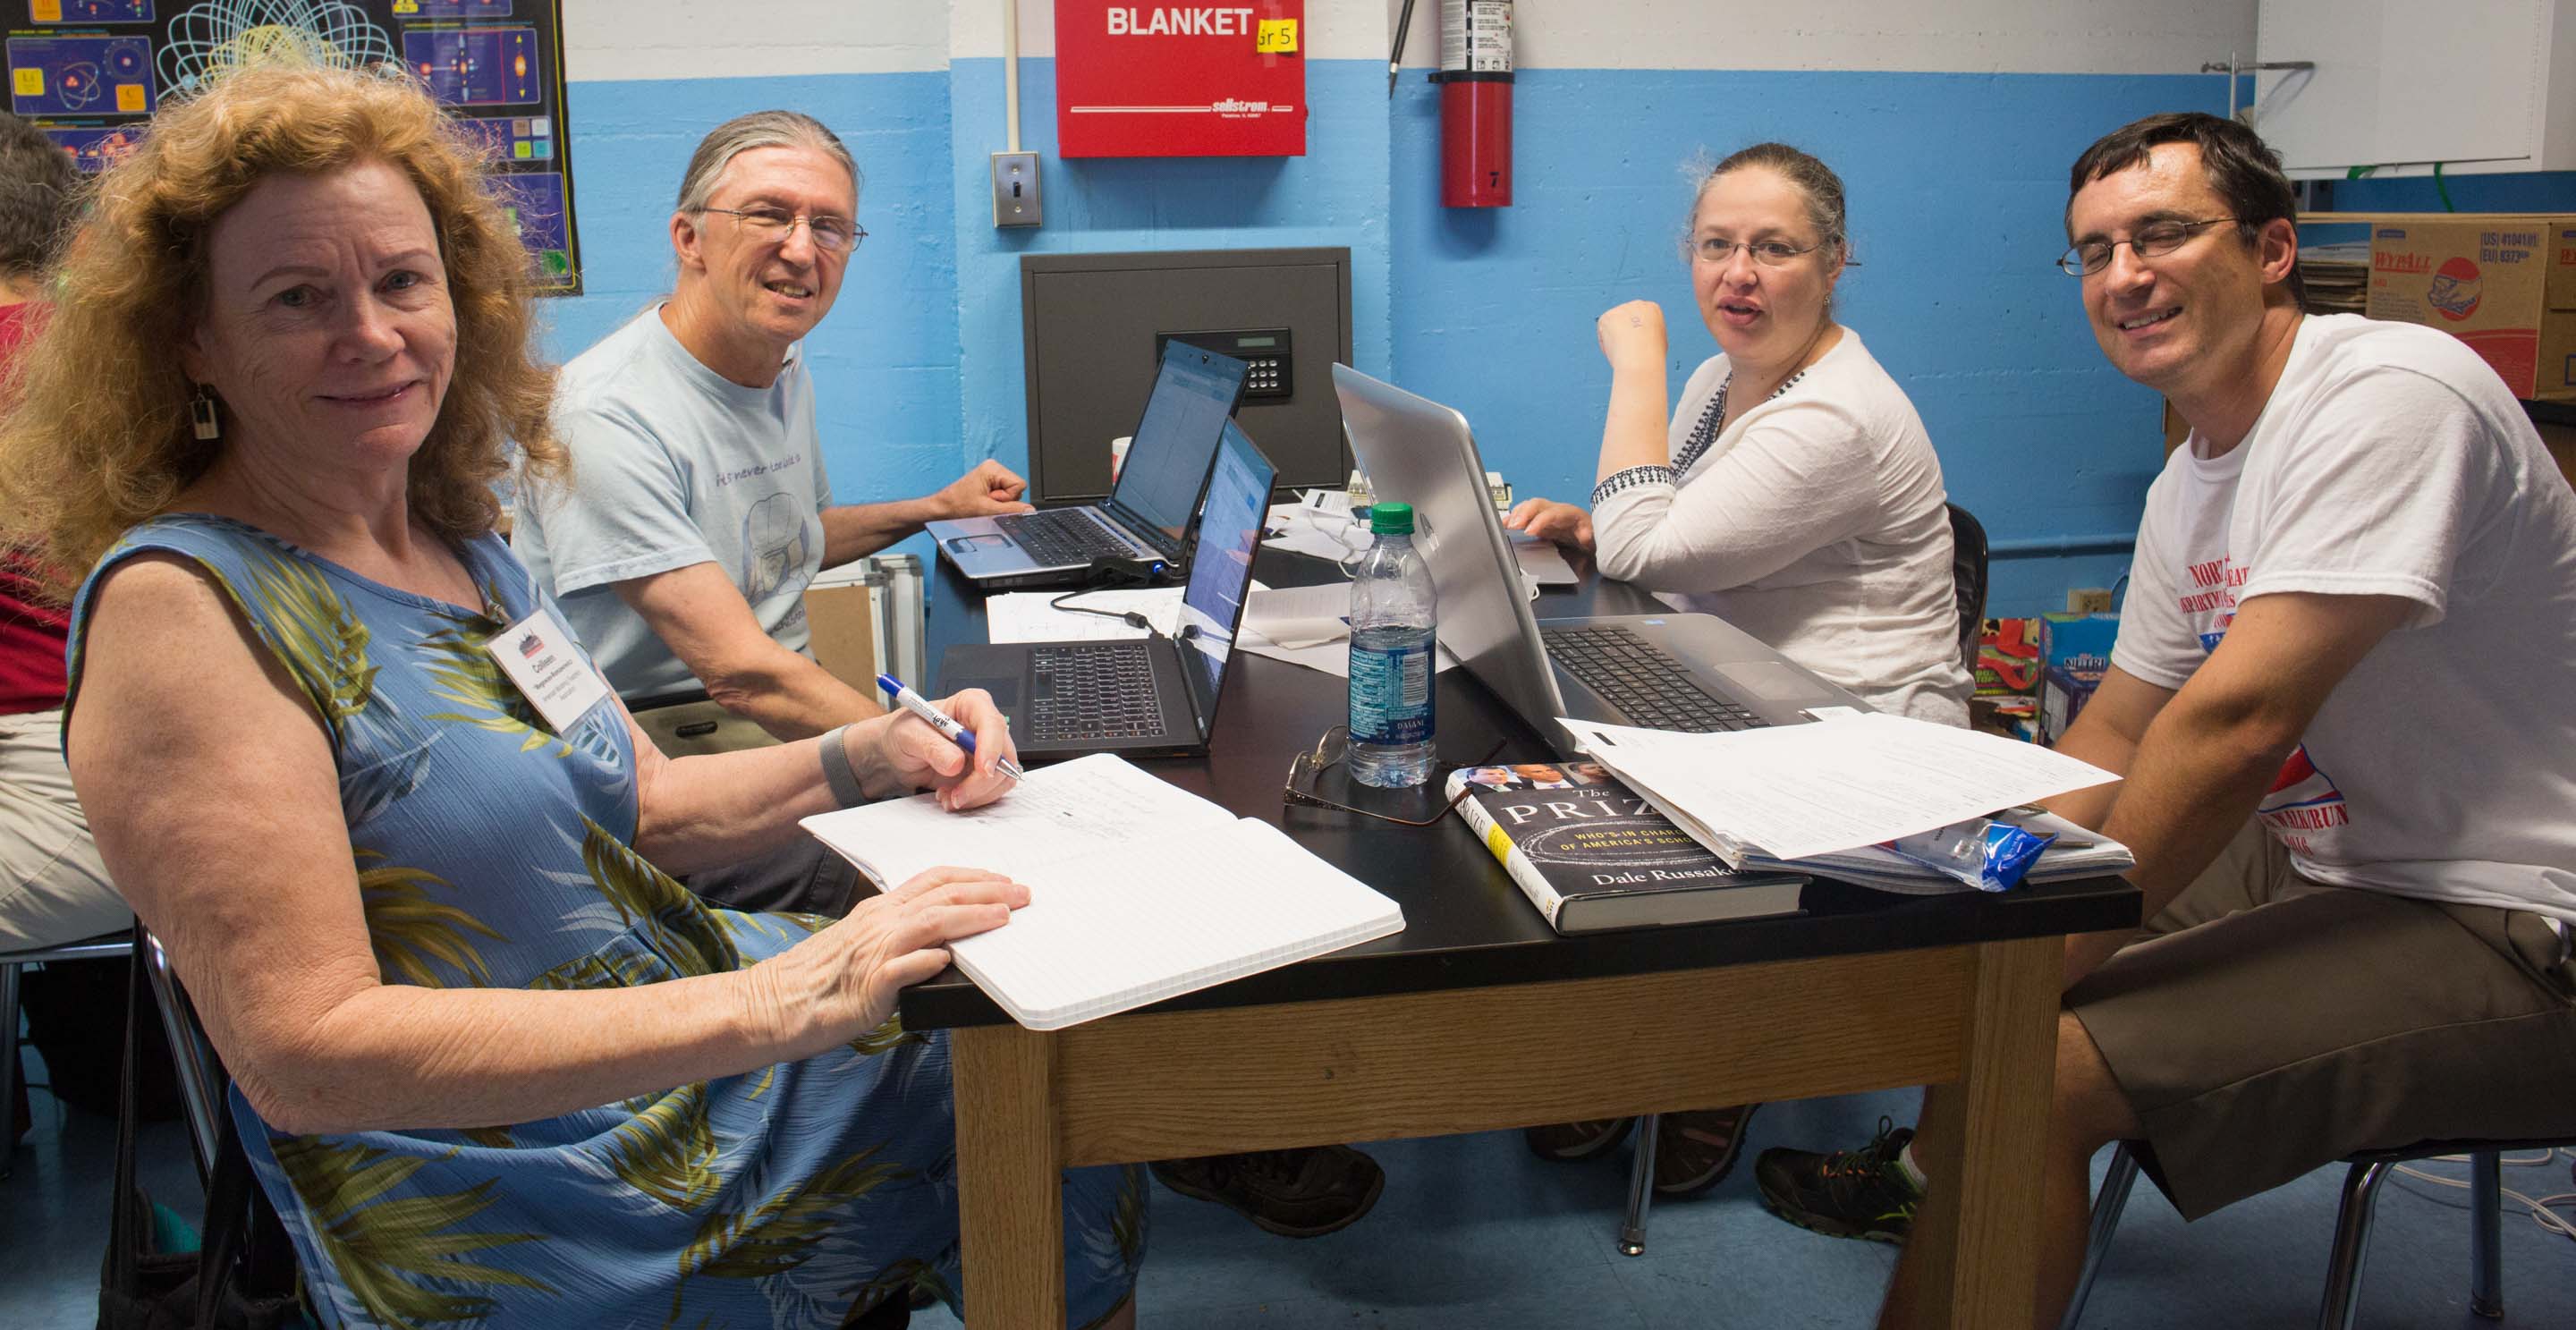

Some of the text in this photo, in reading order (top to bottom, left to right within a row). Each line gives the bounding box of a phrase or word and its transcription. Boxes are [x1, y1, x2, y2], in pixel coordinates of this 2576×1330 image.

[1107, 8, 1253, 35] BLANKET
[1280, 28, 1291, 44] 5
[1212, 98, 1268, 113] sellstrom
[1489, 171, 1500, 188] 7
[734, 465, 767, 480] never
[1572, 790, 1610, 798] The
[1501, 799, 1661, 825] PRIZ
[1640, 828, 1684, 837] CHARG
[1560, 835, 1691, 851] OF AMERICA'S SCHO
[1591, 865, 1733, 885] Dale Russak
